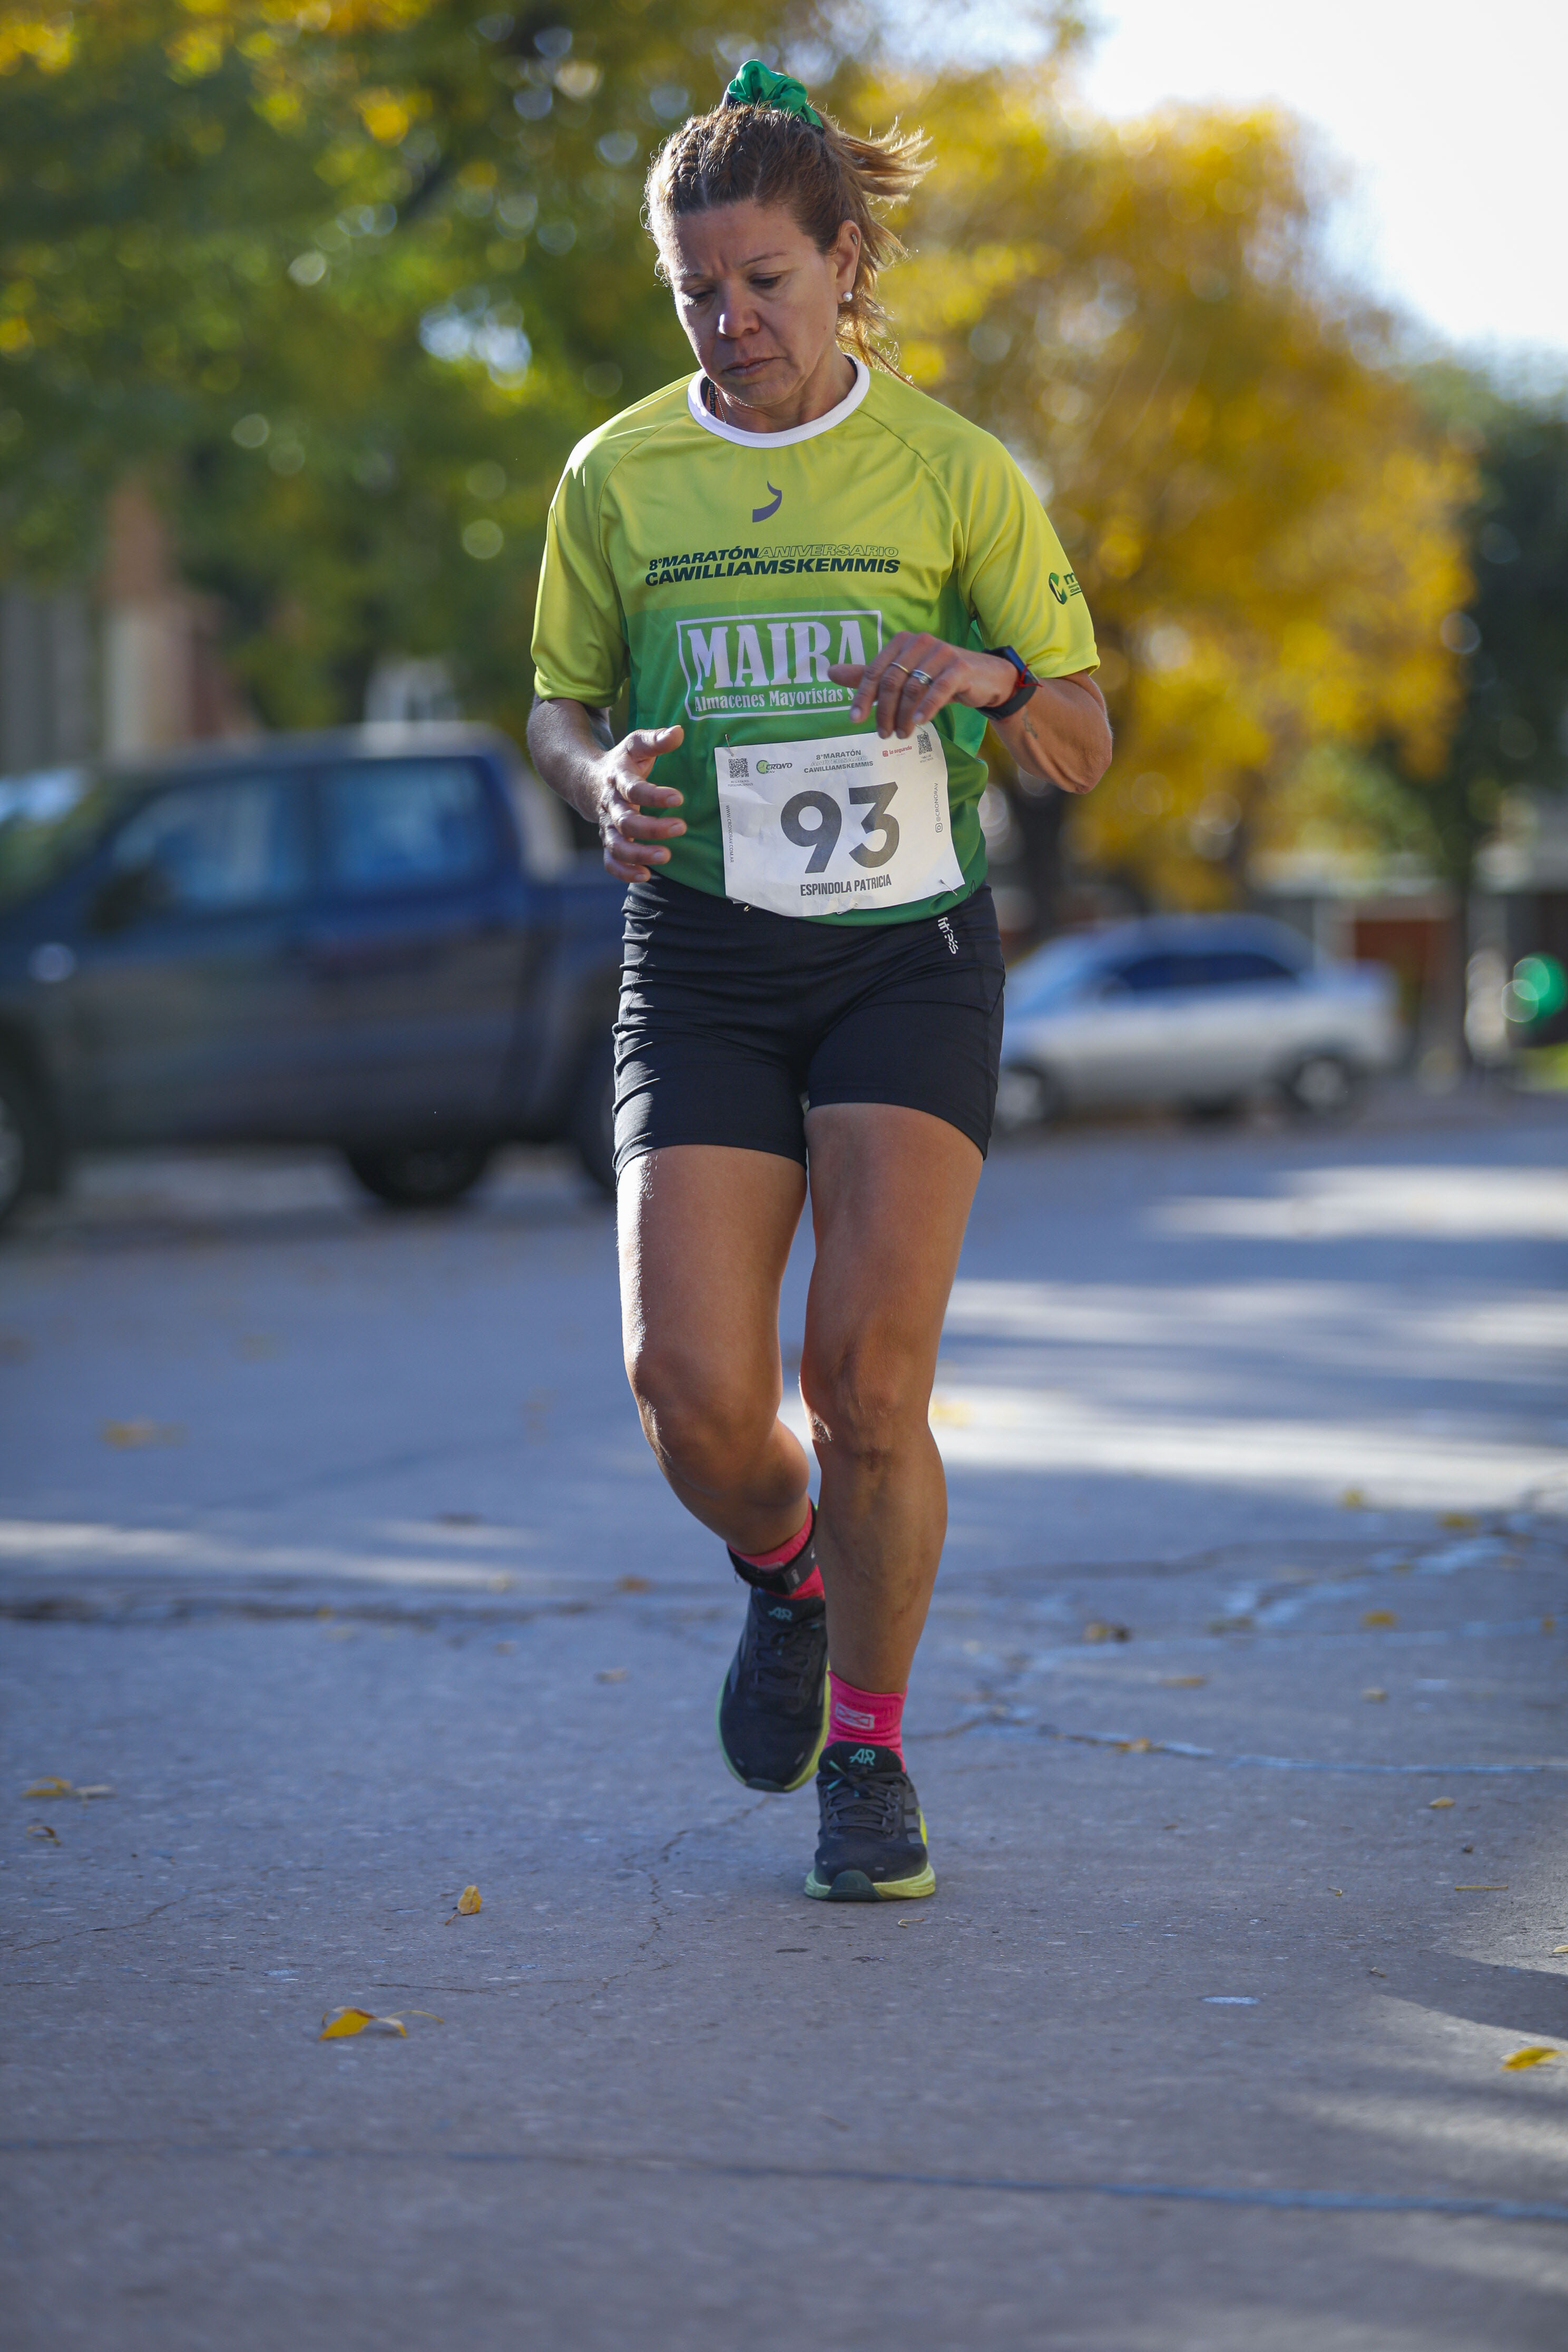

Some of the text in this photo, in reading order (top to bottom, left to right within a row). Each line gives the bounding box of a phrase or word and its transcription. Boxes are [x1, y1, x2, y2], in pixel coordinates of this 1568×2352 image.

[645, 558, 901, 586] CAWILLIAMSKEMMIS
[687, 620, 866, 691] MAIRA
[694, 694, 765, 712] Almacenes
[803, 761, 874, 773] CAWILLIAMSKEMMIS
[726, 805, 734, 863] WWW.CRONORAV.COM.AR
[780, 781, 900, 874] 93
[800, 874, 891, 896] ESPINDOLA PATRICIA
